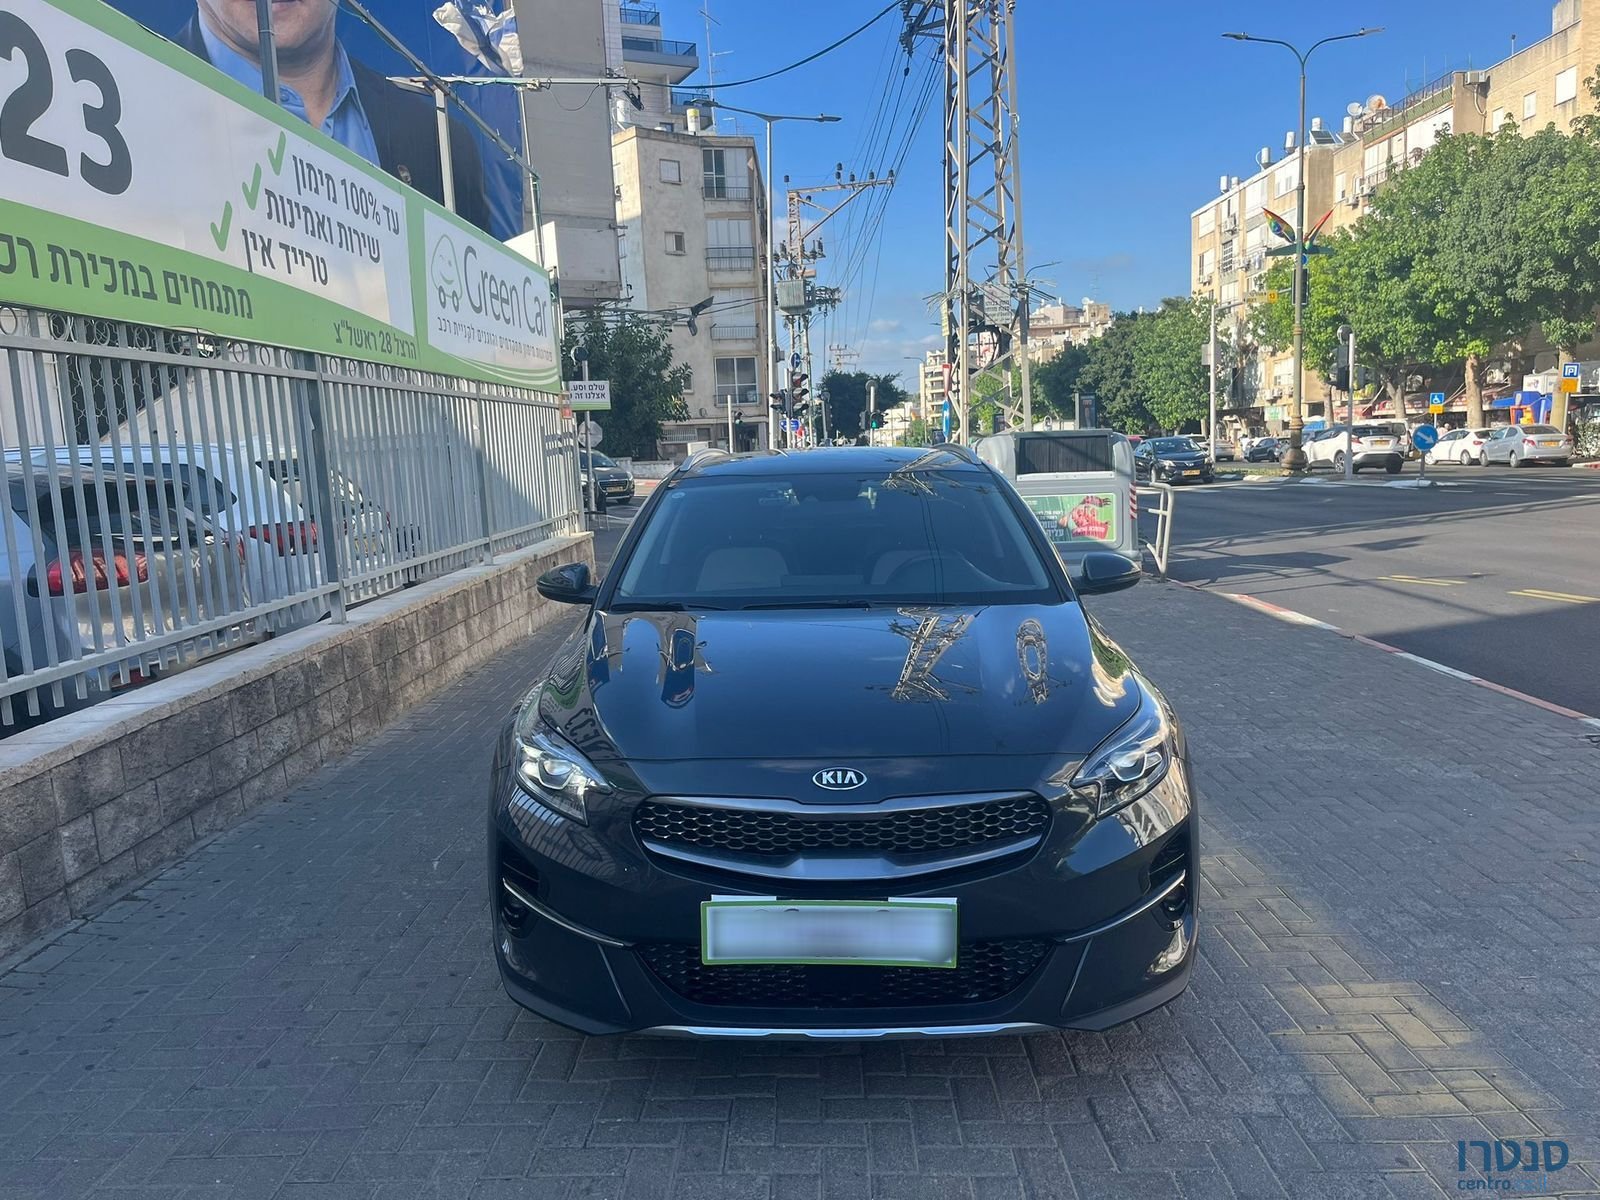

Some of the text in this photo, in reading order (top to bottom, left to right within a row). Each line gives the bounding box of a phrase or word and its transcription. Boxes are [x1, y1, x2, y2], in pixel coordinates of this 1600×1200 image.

[0, 10, 133, 195] 23
[292, 154, 400, 236] עד 100% מימון
[264, 188, 381, 264] שירות ואמינות
[46, 243, 158, 301] במכירת
[241, 228, 328, 286] טרייד אין
[162, 270, 253, 319] מתמחים
[464, 245, 547, 338] Green Car
[333, 320, 416, 360] הרצל 28 ראשל"צ
[437, 316, 452, 334] רכב
[453, 323, 475, 343] לקניית
[585, 391, 606, 399] אצלנו
[588, 383, 605, 391] שלם
[822, 770, 858, 784] KIA
